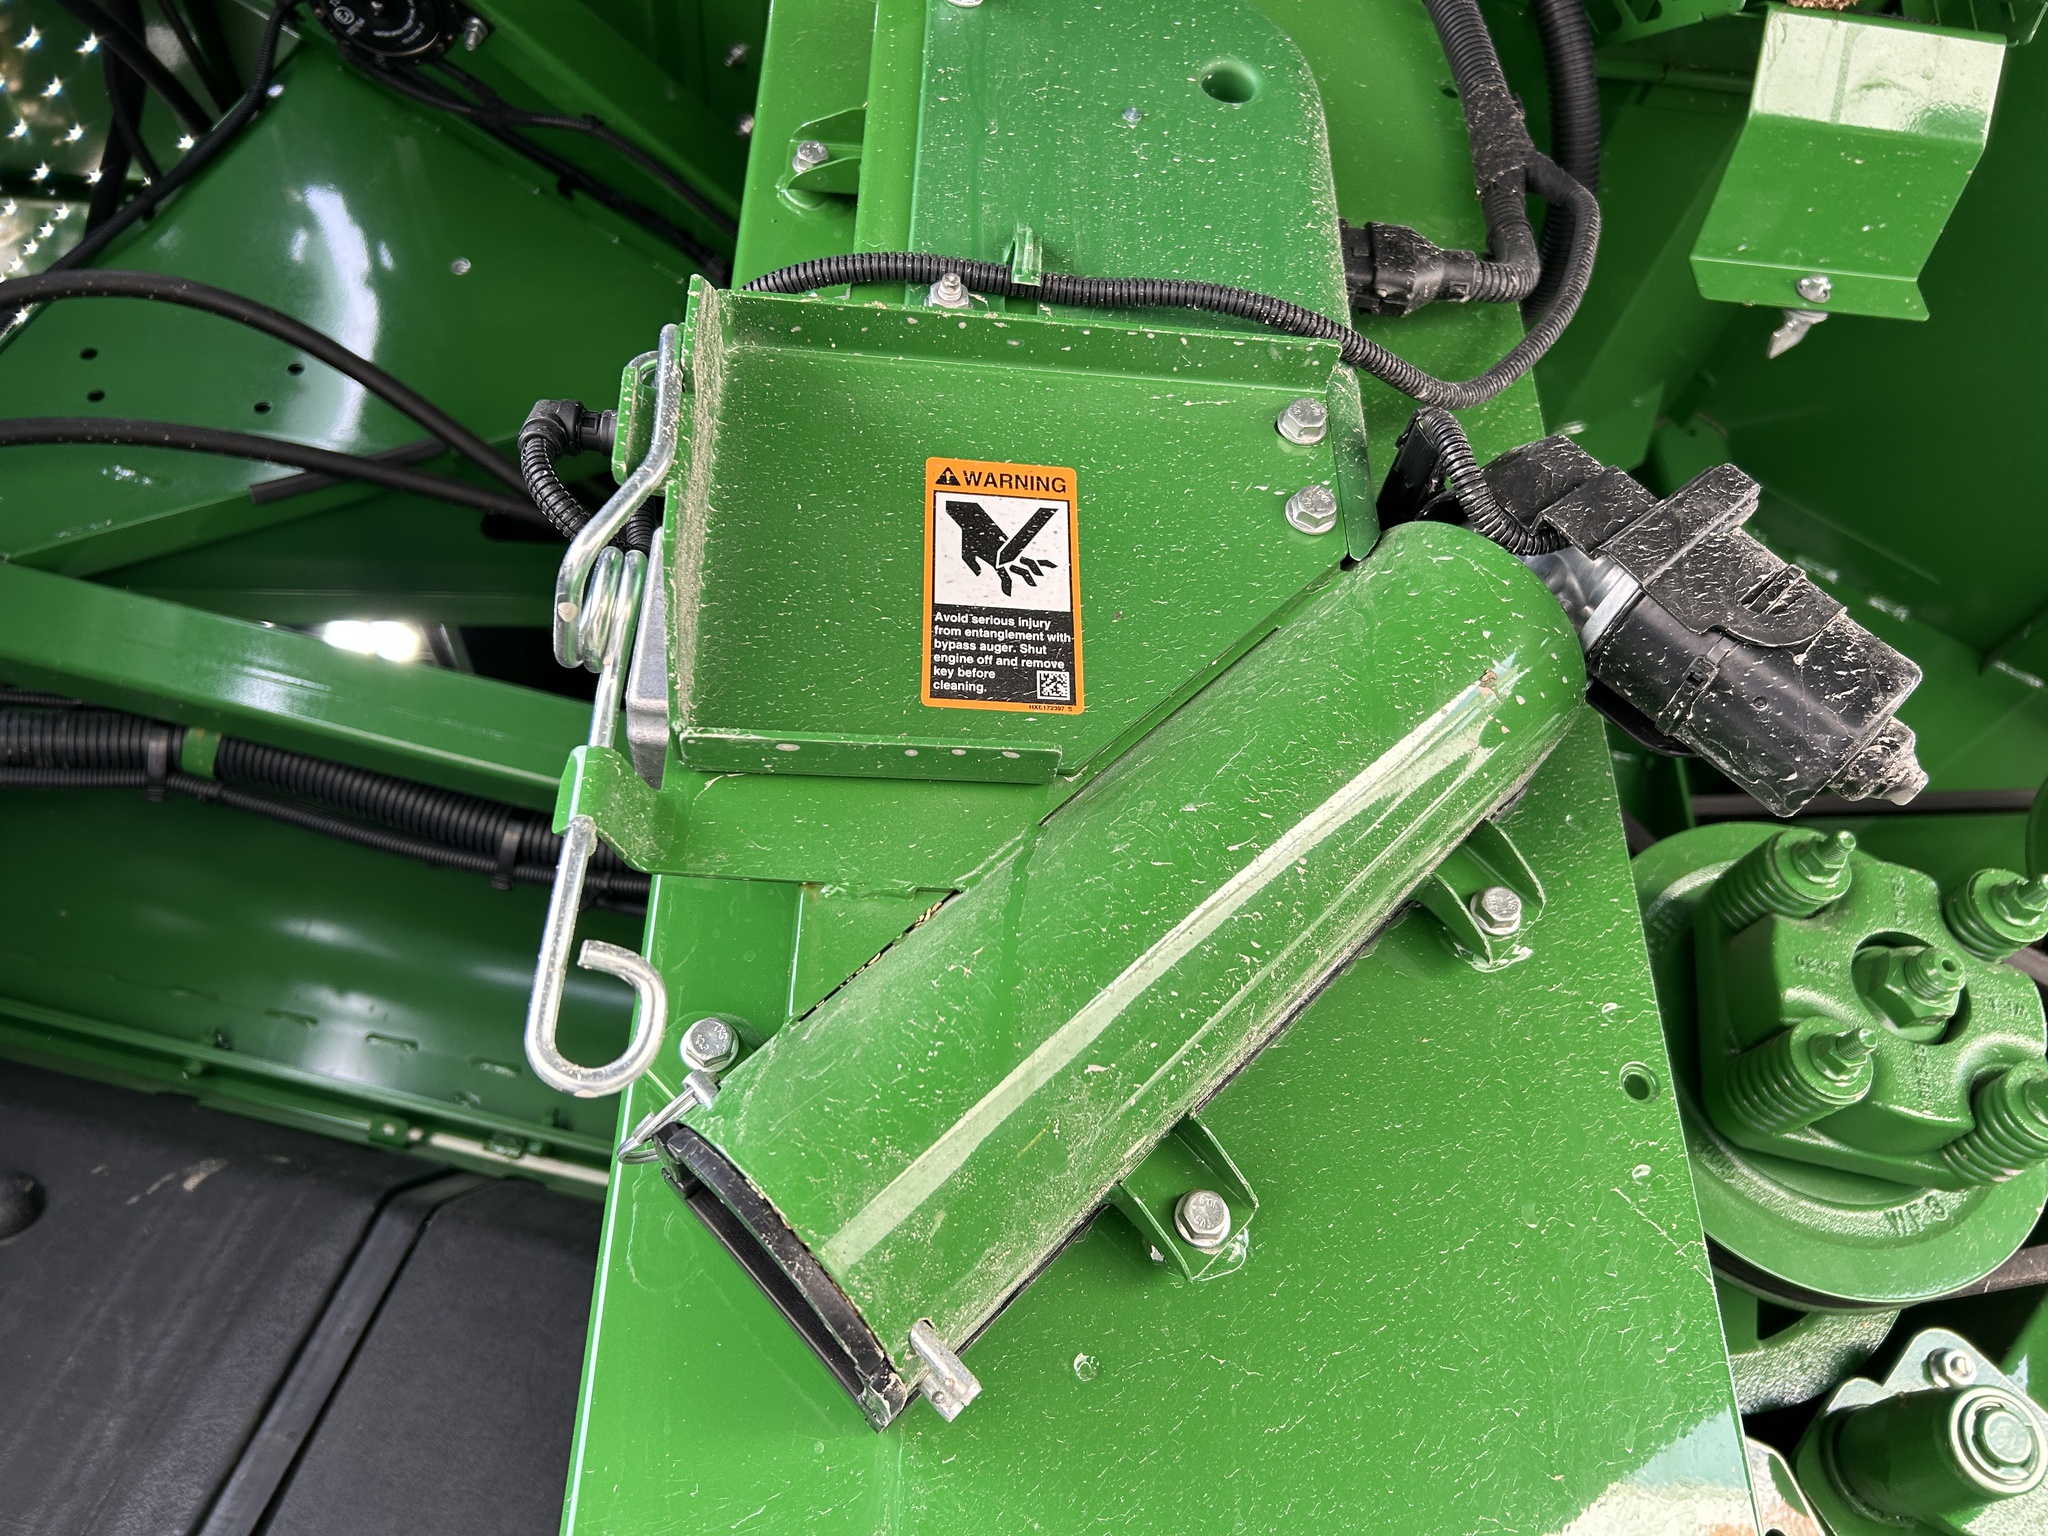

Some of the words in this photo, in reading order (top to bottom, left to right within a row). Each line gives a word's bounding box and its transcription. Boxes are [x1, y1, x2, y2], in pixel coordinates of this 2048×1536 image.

[962, 469, 1067, 493] WARNING
[934, 611, 969, 623] Avoid
[971, 614, 1015, 626] serious
[1018, 617, 1051, 630] injury
[934, 625, 962, 636] from
[964, 628, 1045, 641] entanglement
[1047, 632, 1072, 643] with
[934, 638, 976, 651] bypass
[979, 642, 1016, 655] auger.
[1019, 643, 1048, 655] Shut
[933, 653, 974, 665] engine
[977, 655, 993, 666] off
[996, 657, 1018, 667] and
[1021, 660, 1065, 670] remove
[933, 666, 954, 679] key
[957, 667, 996, 679] before
[932, 680, 987, 694] cleaning.
